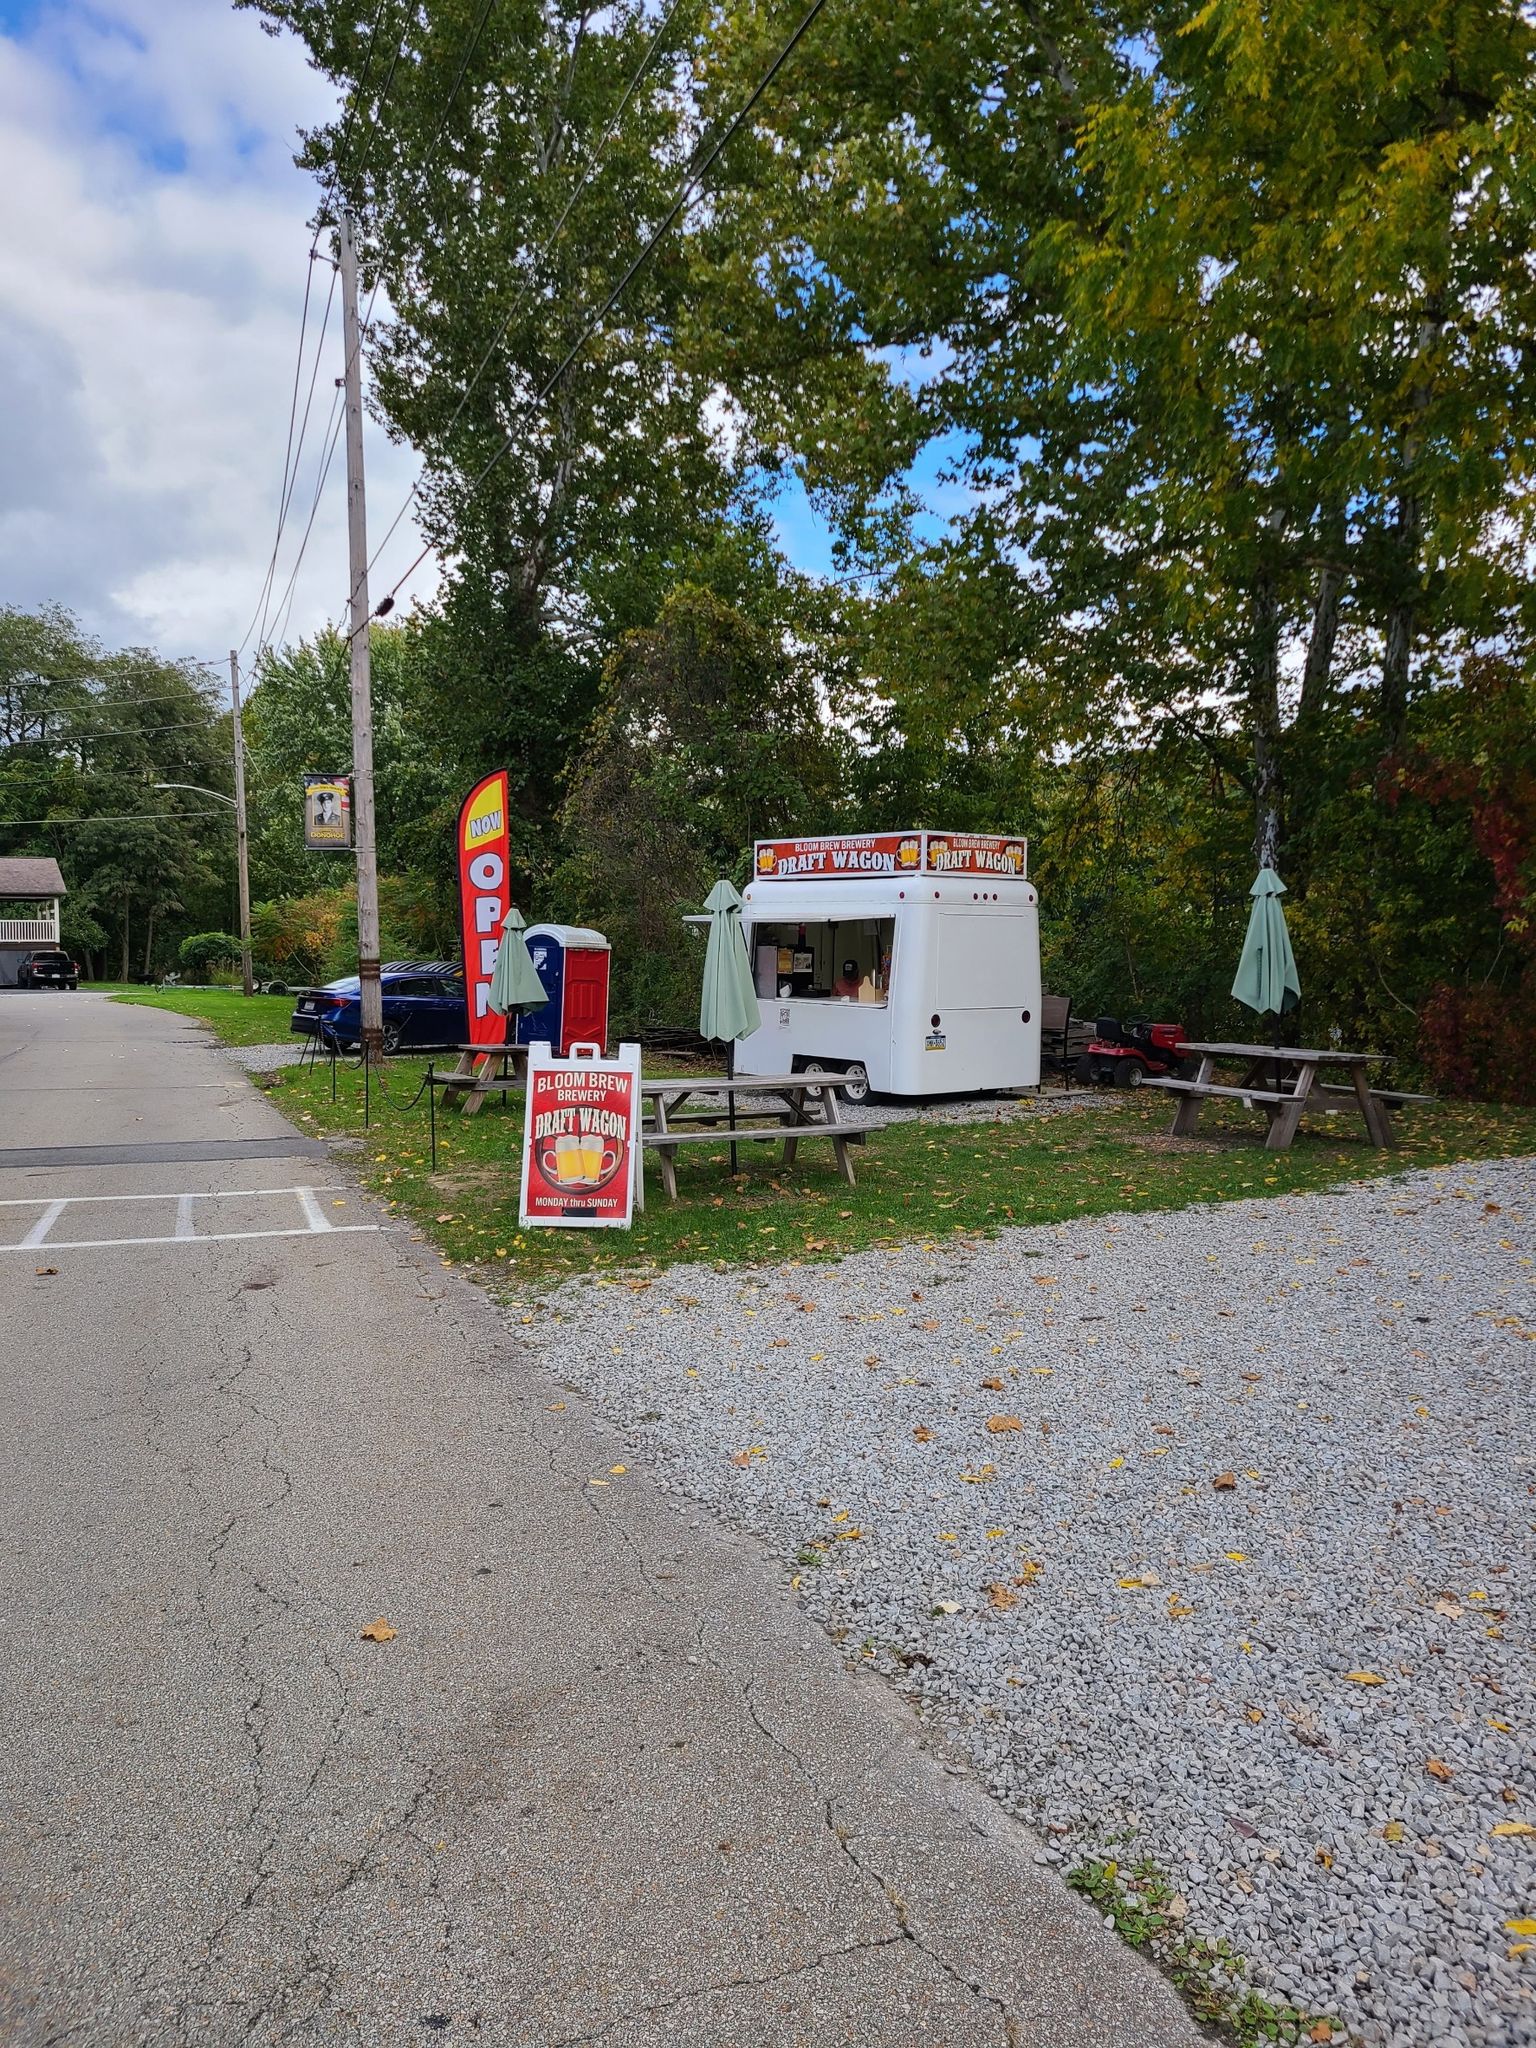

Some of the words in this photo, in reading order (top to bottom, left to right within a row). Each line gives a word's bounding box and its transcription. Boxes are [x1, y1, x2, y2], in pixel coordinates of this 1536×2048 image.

[470, 811, 501, 838] NOW
[795, 842, 819, 853] BLOOM
[820, 841, 840, 851] BREW
[841, 839, 876, 850] BREWERY
[953, 838, 968, 848] BLOOM
[969, 839, 980, 849] BREW
[778, 852, 827, 875] DRAFT
[832, 850, 895, 872] WAGON
[937, 850, 971, 871] DRAFT
[976, 850, 1016, 875] WAGON
[537, 1072, 585, 1093] BLOOM
[589, 1072, 628, 1093] BREW
[557, 1090, 606, 1102] BREWERY
[535, 1108, 577, 1140] DRAFT
[579, 1108, 627, 1141] WAGON
[535, 1197, 568, 1207] MONDAY
[570, 1198, 585, 1206] thru
[587, 1198, 618, 1208] SUNDAY
